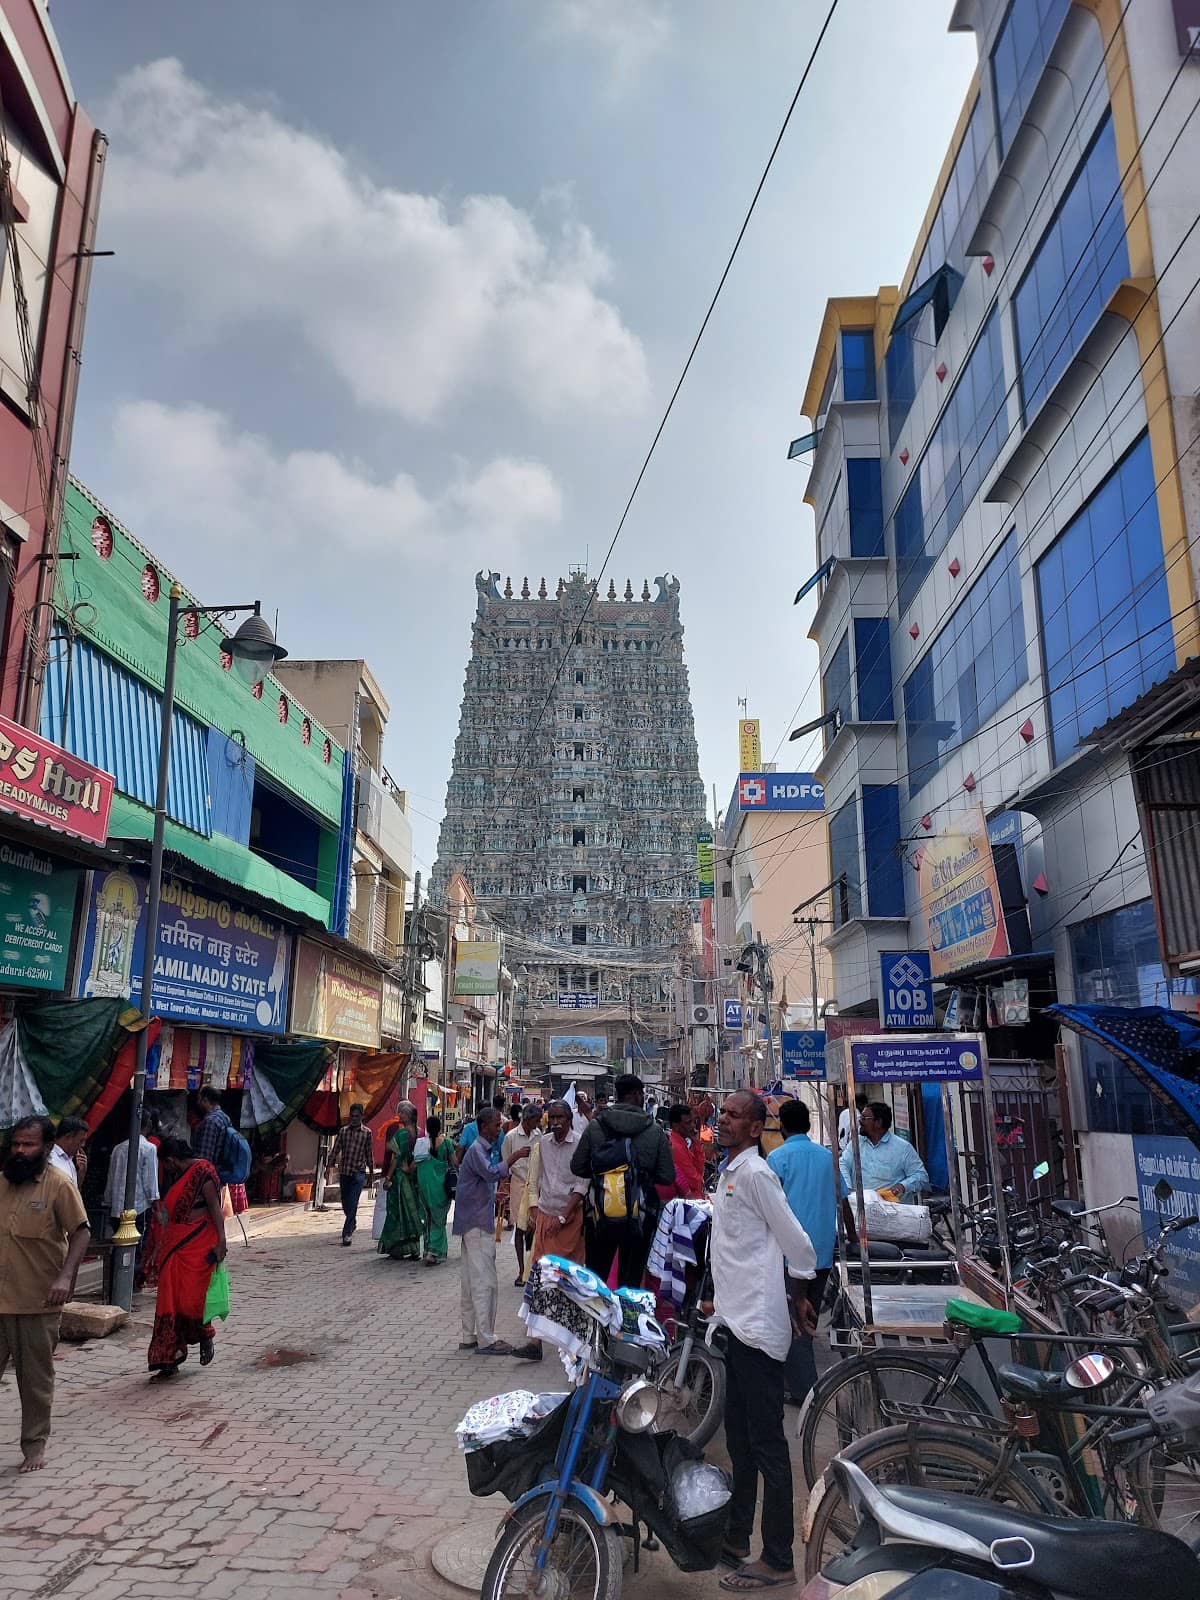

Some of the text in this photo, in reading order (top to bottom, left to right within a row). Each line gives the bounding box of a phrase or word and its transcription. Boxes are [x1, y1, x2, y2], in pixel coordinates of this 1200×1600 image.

[40, 757, 100, 813] Hall
[773, 785, 824, 799] HDFC
[145, 880, 231, 929] மிழ்நாடு
[25, 923, 47, 938] ACCEPT
[47, 930, 57, 940] ALL
[5, 934, 63, 953] DEBIT/CREDIT CARDS
[160, 920, 204, 953] तमिल
[207, 937, 233, 967] नाडु
[231, 974, 266, 997] STATE
[889, 989, 927, 1011] IOB
[886, 1016, 906, 1026] ATM
[913, 1015, 934, 1027] CDM
[785, 1049, 802, 1058] Indian
[1141, 1184, 1167, 1214] HOTL
